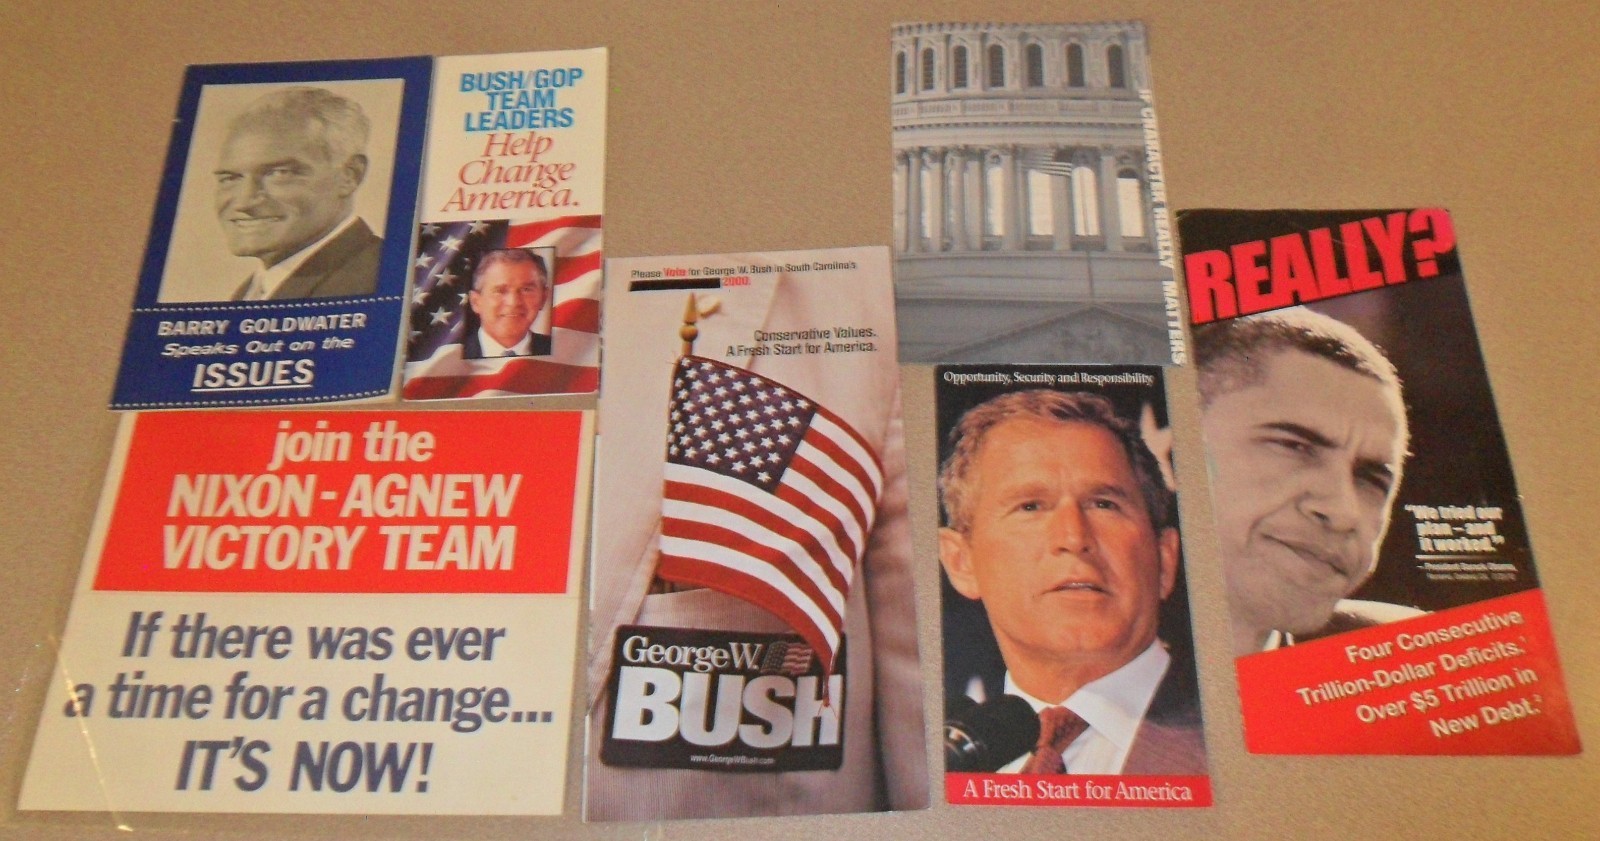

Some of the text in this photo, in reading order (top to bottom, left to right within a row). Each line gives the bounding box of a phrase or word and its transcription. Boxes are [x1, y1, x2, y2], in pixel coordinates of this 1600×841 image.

[460, 67, 584, 93] BUSH/GOP
[487, 89, 555, 111] TEAM
[464, 108, 574, 132] LEADERS
[482, 131, 553, 164] Help
[458, 158, 576, 191] Change
[439, 183, 581, 214] America.
[631, 269, 662, 279] Please
[663, 267, 687, 278] Vote
[688, 266, 701, 276] for
[703, 265, 735, 277] George
[737, 265, 749, 275] W.
[751, 264, 772, 274] Bush
[774, 263, 783, 273] in
[785, 262, 811, 273] South
[1184, 207, 1458, 325] REALLY?
[158, 312, 367, 337] BARRY GOLDWATER
[754, 326, 877, 342] Conservative Values.
[1162, 280, 1187, 365] MATTERS
[161, 335, 356, 357] Speaks Out on the
[726, 340, 877, 357] A Fresh Start for America.
[193, 358, 315, 387] ISSUES
[943, 371, 1154, 387] Opportunity, Security and Responsibility
[268, 420, 436, 471] join the
[162, 525, 518, 571] VICTORY TEAM
[121, 610, 506, 662] If there was ever
[1344, 609, 1524, 665] Four Consecutive
[1296, 660, 1437, 706] Trillion-Dollar
[1356, 666, 1539, 724] Over $5 Trillion in
[64, 670, 553, 733] a time for a change...
[611, 665, 843, 749] BUSH
[1429, 715, 1480, 739] New
[175, 736, 435, 792] IT'S NOW!
[963, 778, 1193, 801] A Fresh Start for America
